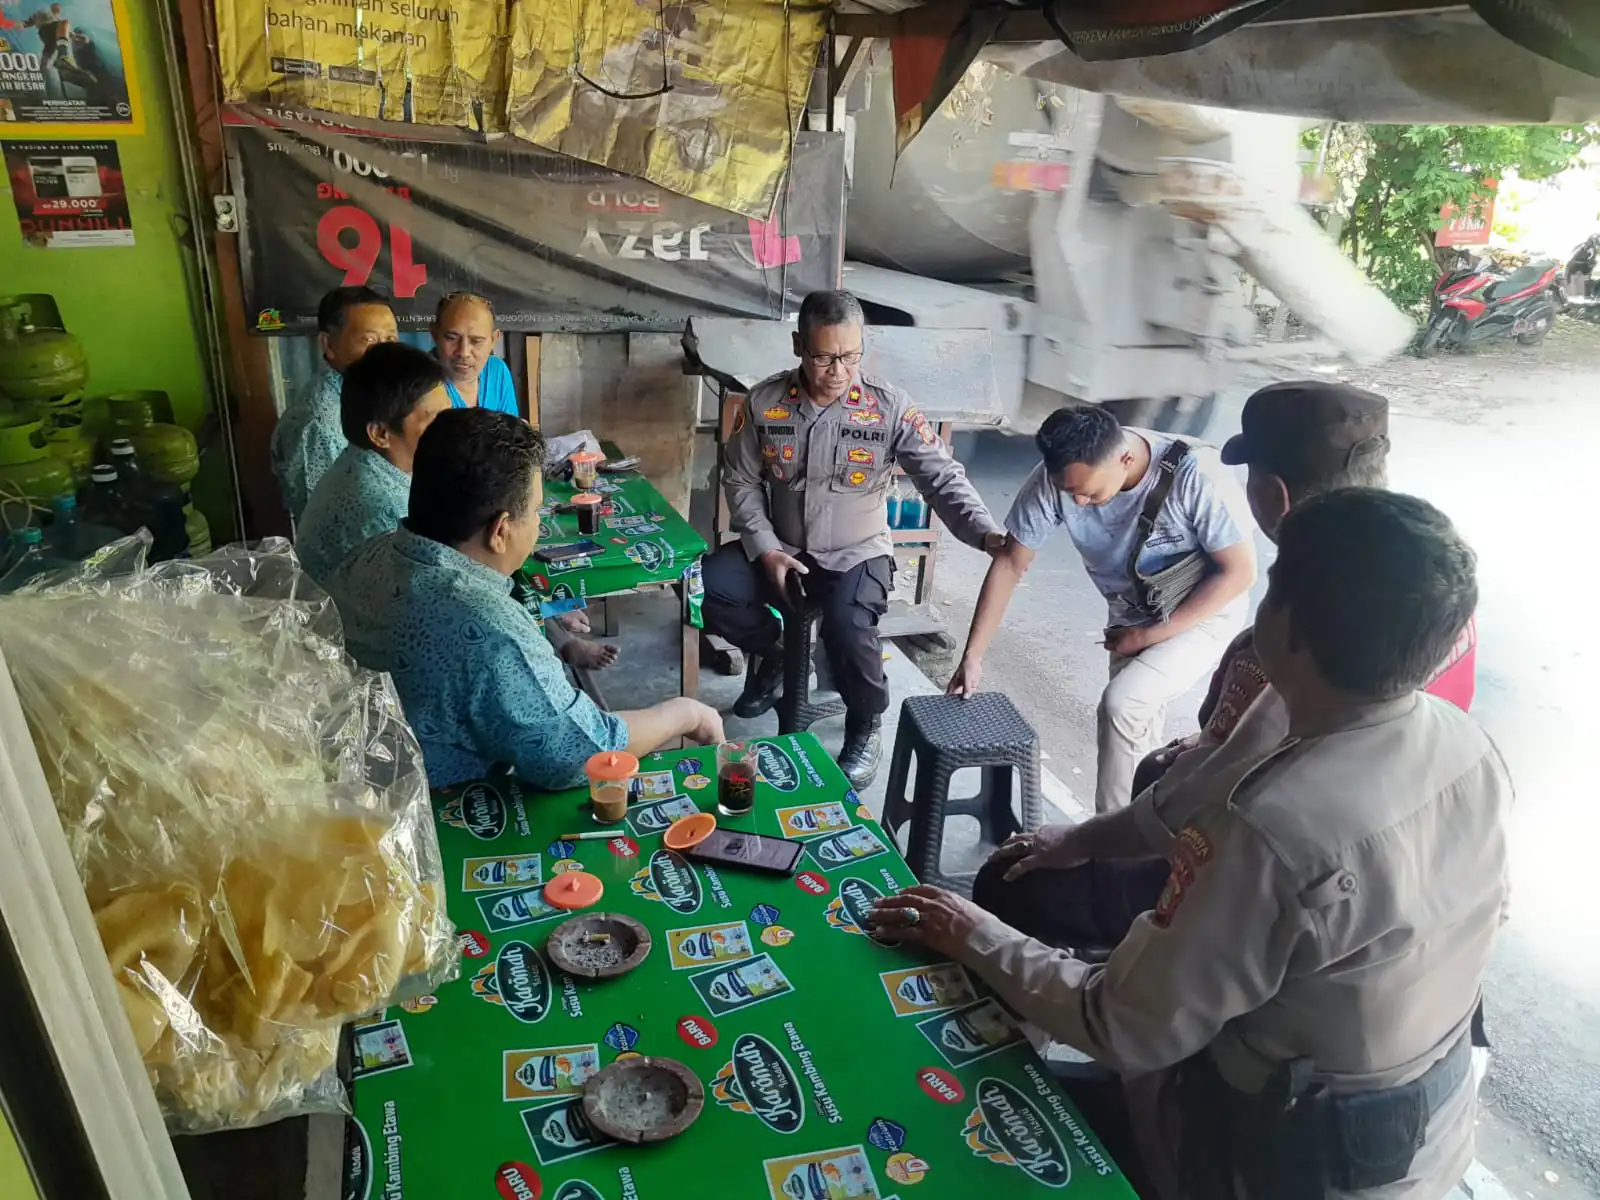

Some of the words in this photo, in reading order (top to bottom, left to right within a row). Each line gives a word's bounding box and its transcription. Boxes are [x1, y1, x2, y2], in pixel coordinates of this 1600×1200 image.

[267, 8, 328, 33] bahan
[336, 21, 428, 49] makanan
[391, 1, 460, 24] seluruh
[587, 189, 660, 208] BOLD
[316, 205, 428, 298] 16
[841, 427, 886, 443] POLRI
[610, 838, 633, 858] BARU
[799, 873, 825, 894] BARU
[500, 946, 544, 1014] Karömah
[569, 995, 584, 1018] Susu
[682, 1018, 713, 1047] BARU
[783, 1021, 805, 1053] Etawa
[736, 1040, 799, 1124] Karömah
[799, 1049, 829, 1097] Kambing
[921, 1071, 959, 1102] BARU
[1023, 1063, 1052, 1096] Etawa
[382, 1099, 399, 1136] Etawa
[820, 1093, 842, 1124] Susu
[1047, 1094, 1089, 1149] Kambing
[982, 1085, 1065, 1176] Karömah
[384, 1132, 403, 1193] Kambing
[1085, 1147, 1113, 1177] Susu
[502, 1166, 535, 1200] BARU
